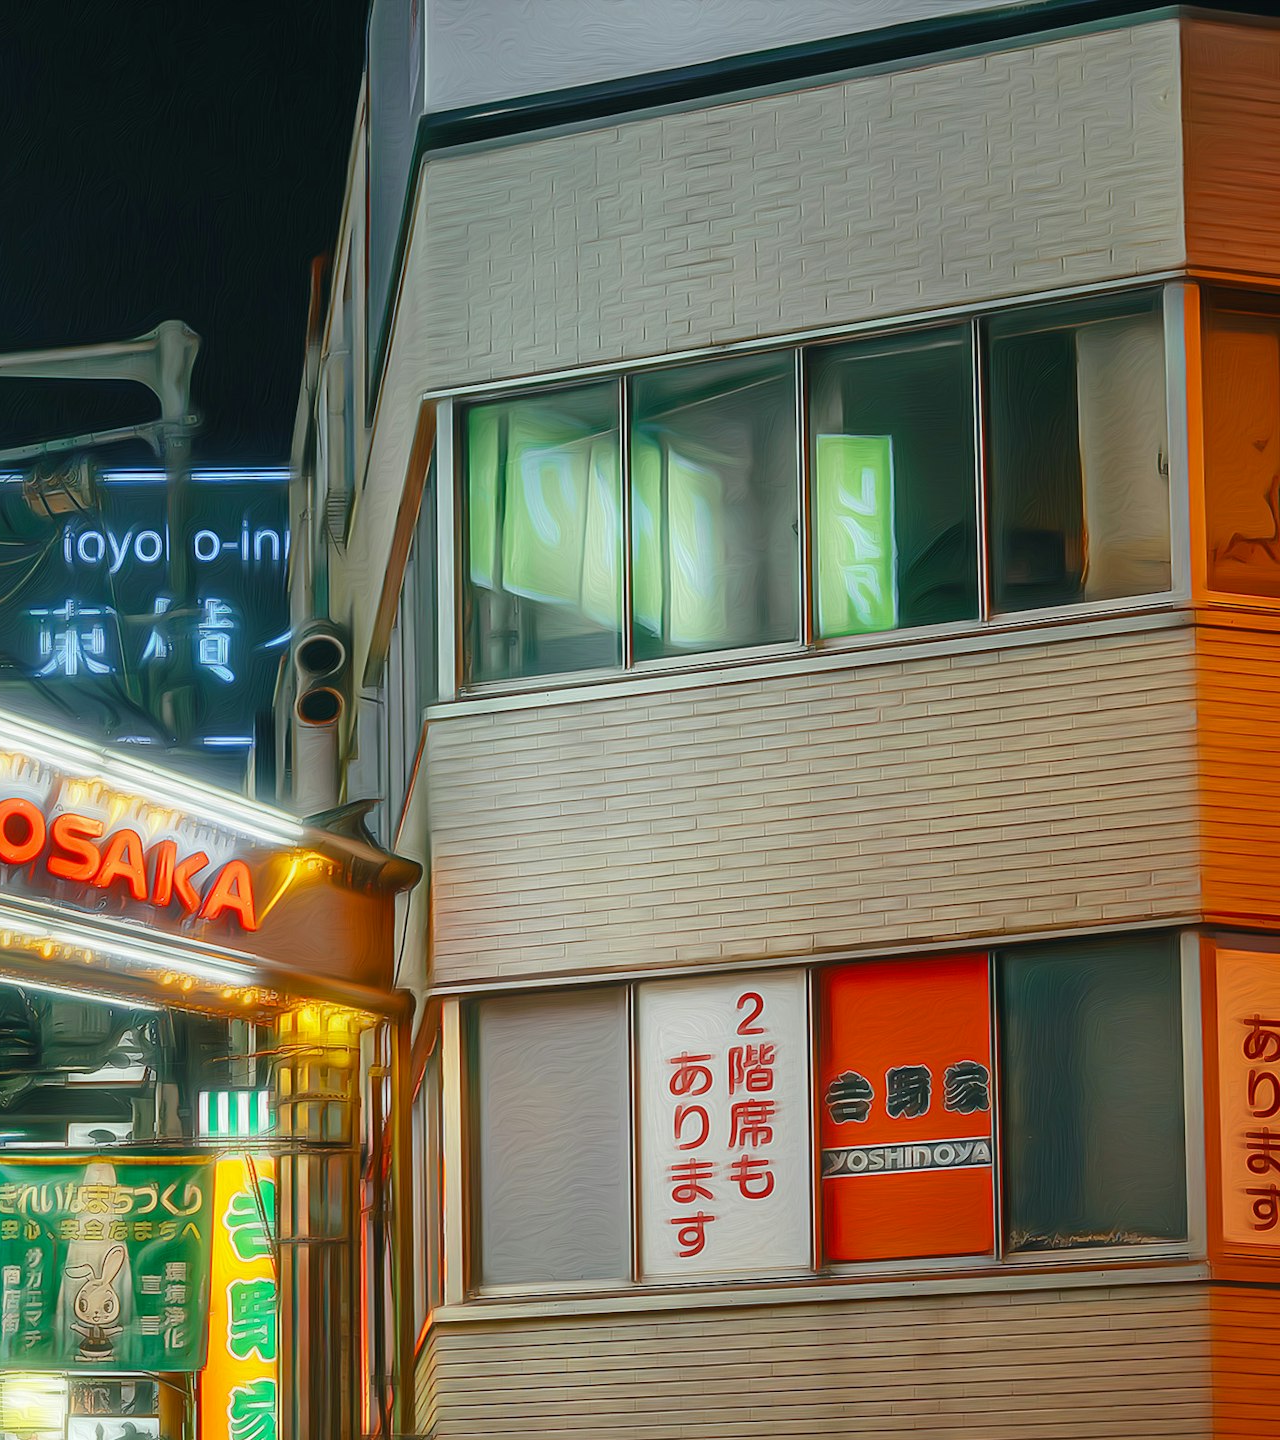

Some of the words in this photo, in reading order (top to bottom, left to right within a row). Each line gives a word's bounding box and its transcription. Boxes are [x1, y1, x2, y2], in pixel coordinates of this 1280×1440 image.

[728, 991, 776, 1200] 2階席も
[825, 1059, 991, 1126] 吉野家
[667, 1049, 716, 1259] あります
[827, 1137, 992, 1176] YOSHINOYA
[0, 1217, 202, 1242] 安心、安全なまちへ
[24, 1247, 44, 1350] サカエマチ
